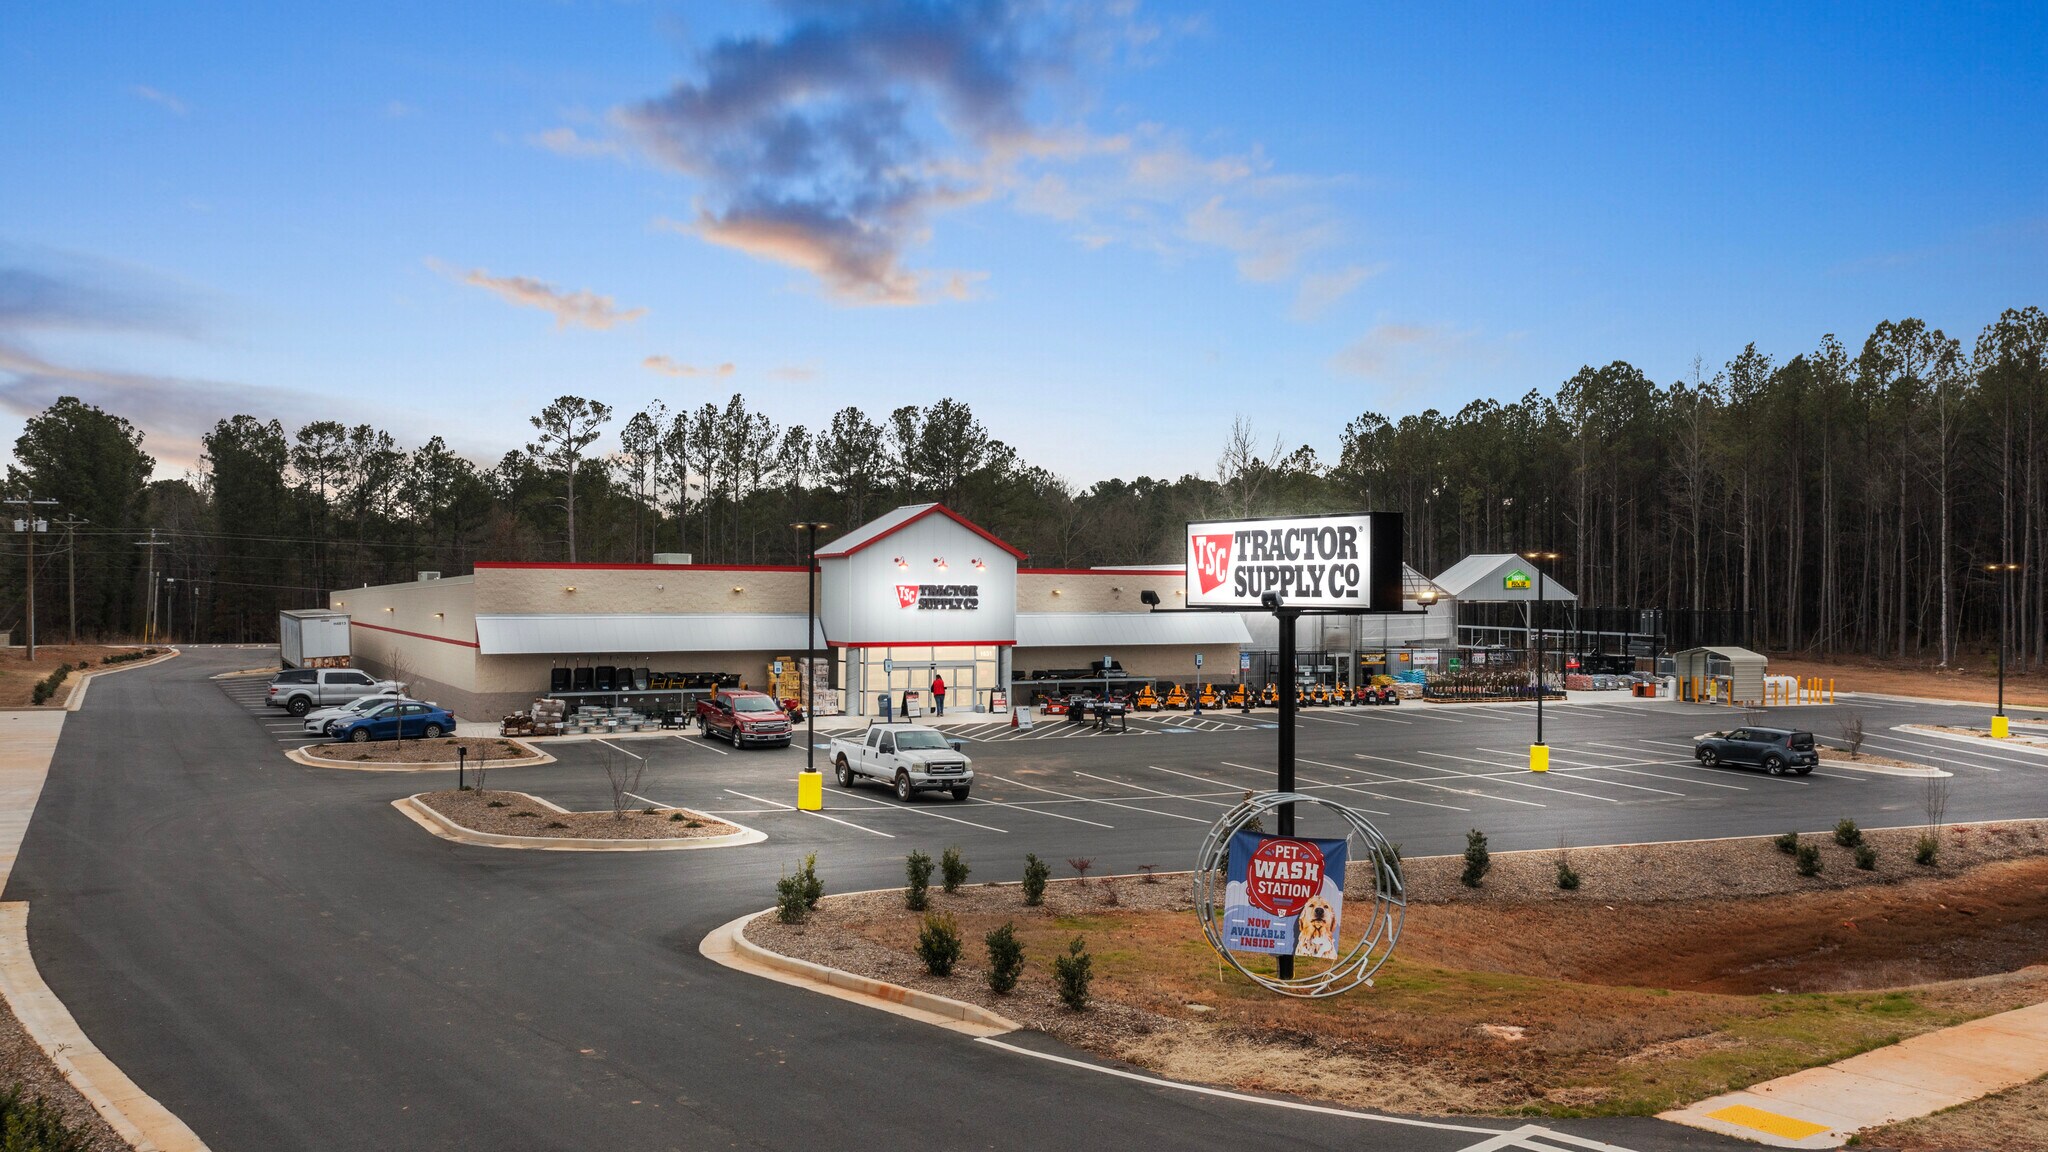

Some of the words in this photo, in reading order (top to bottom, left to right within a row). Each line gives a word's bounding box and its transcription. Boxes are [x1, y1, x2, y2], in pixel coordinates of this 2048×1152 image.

[1234, 525, 1358, 562] TRACTOR
[1195, 536, 1227, 583] TSC
[1234, 564, 1326, 598] SUPPLY
[898, 585, 915, 604] TSC
[918, 584, 979, 597] TRACTOR
[918, 598, 963, 610] SUPPLY
[1275, 844, 1299, 860] PET
[1254, 859, 1320, 882] WASH
[1258, 881, 1311, 898] STATION
[1247, 917, 1271, 929] NOW
[1230, 926, 1286, 940] AVAILABLE
[1240, 937, 1275, 949] INSIDE
